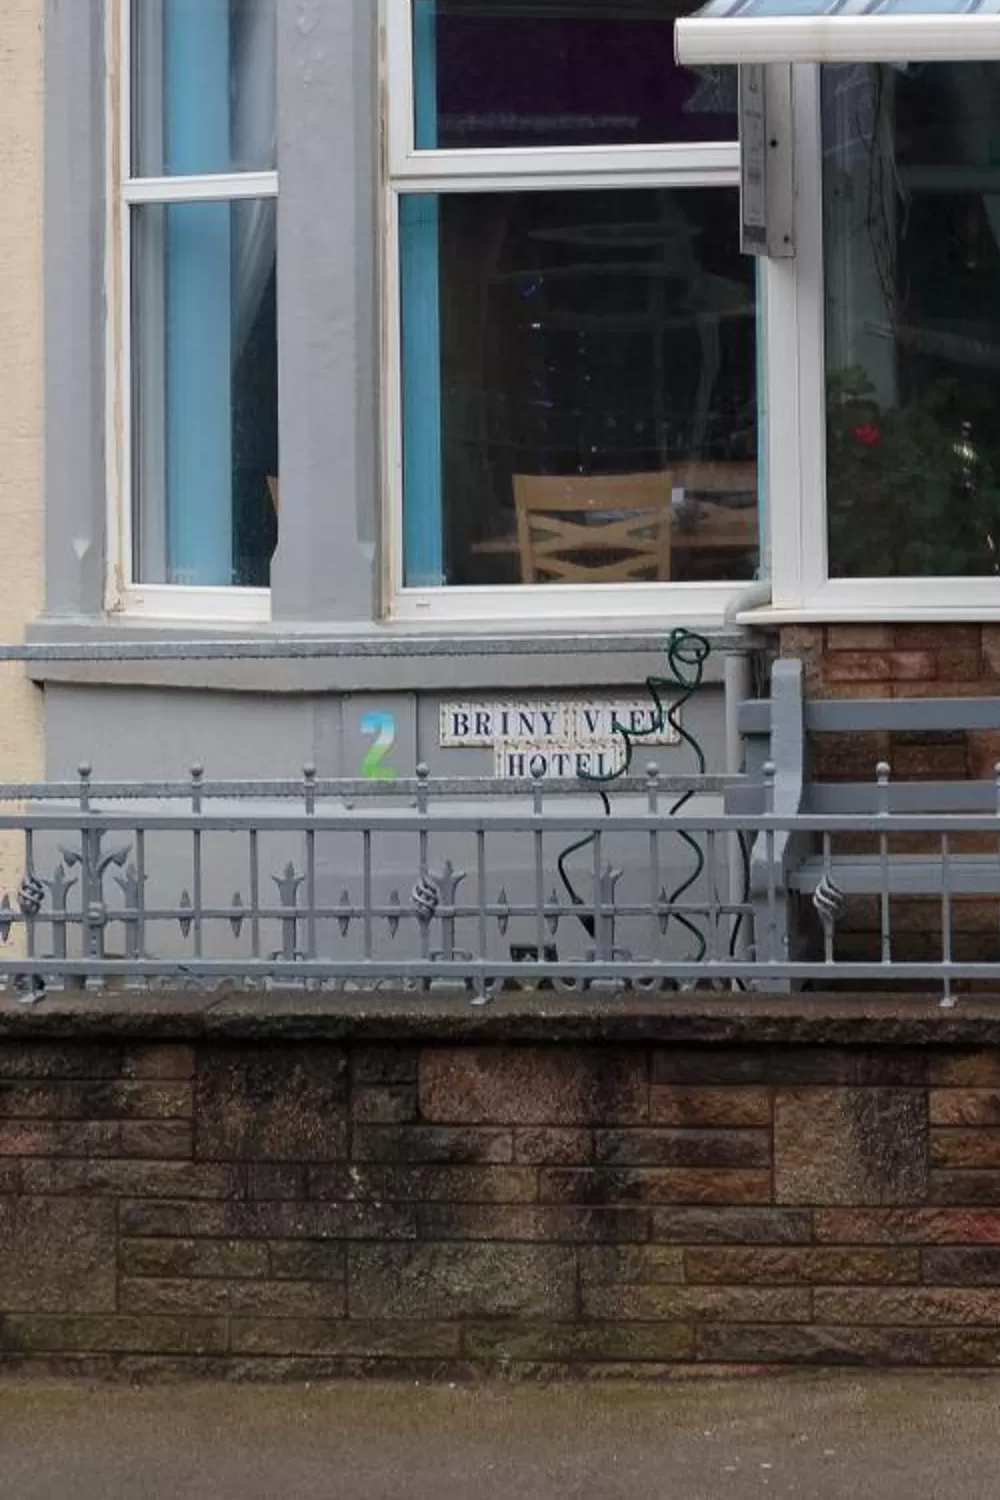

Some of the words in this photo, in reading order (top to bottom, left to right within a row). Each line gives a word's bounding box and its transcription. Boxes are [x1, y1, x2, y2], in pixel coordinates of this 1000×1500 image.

[451, 711, 557, 737] BRINY
[359, 708, 396, 780] 2
[507, 751, 613, 778] HOTEL
